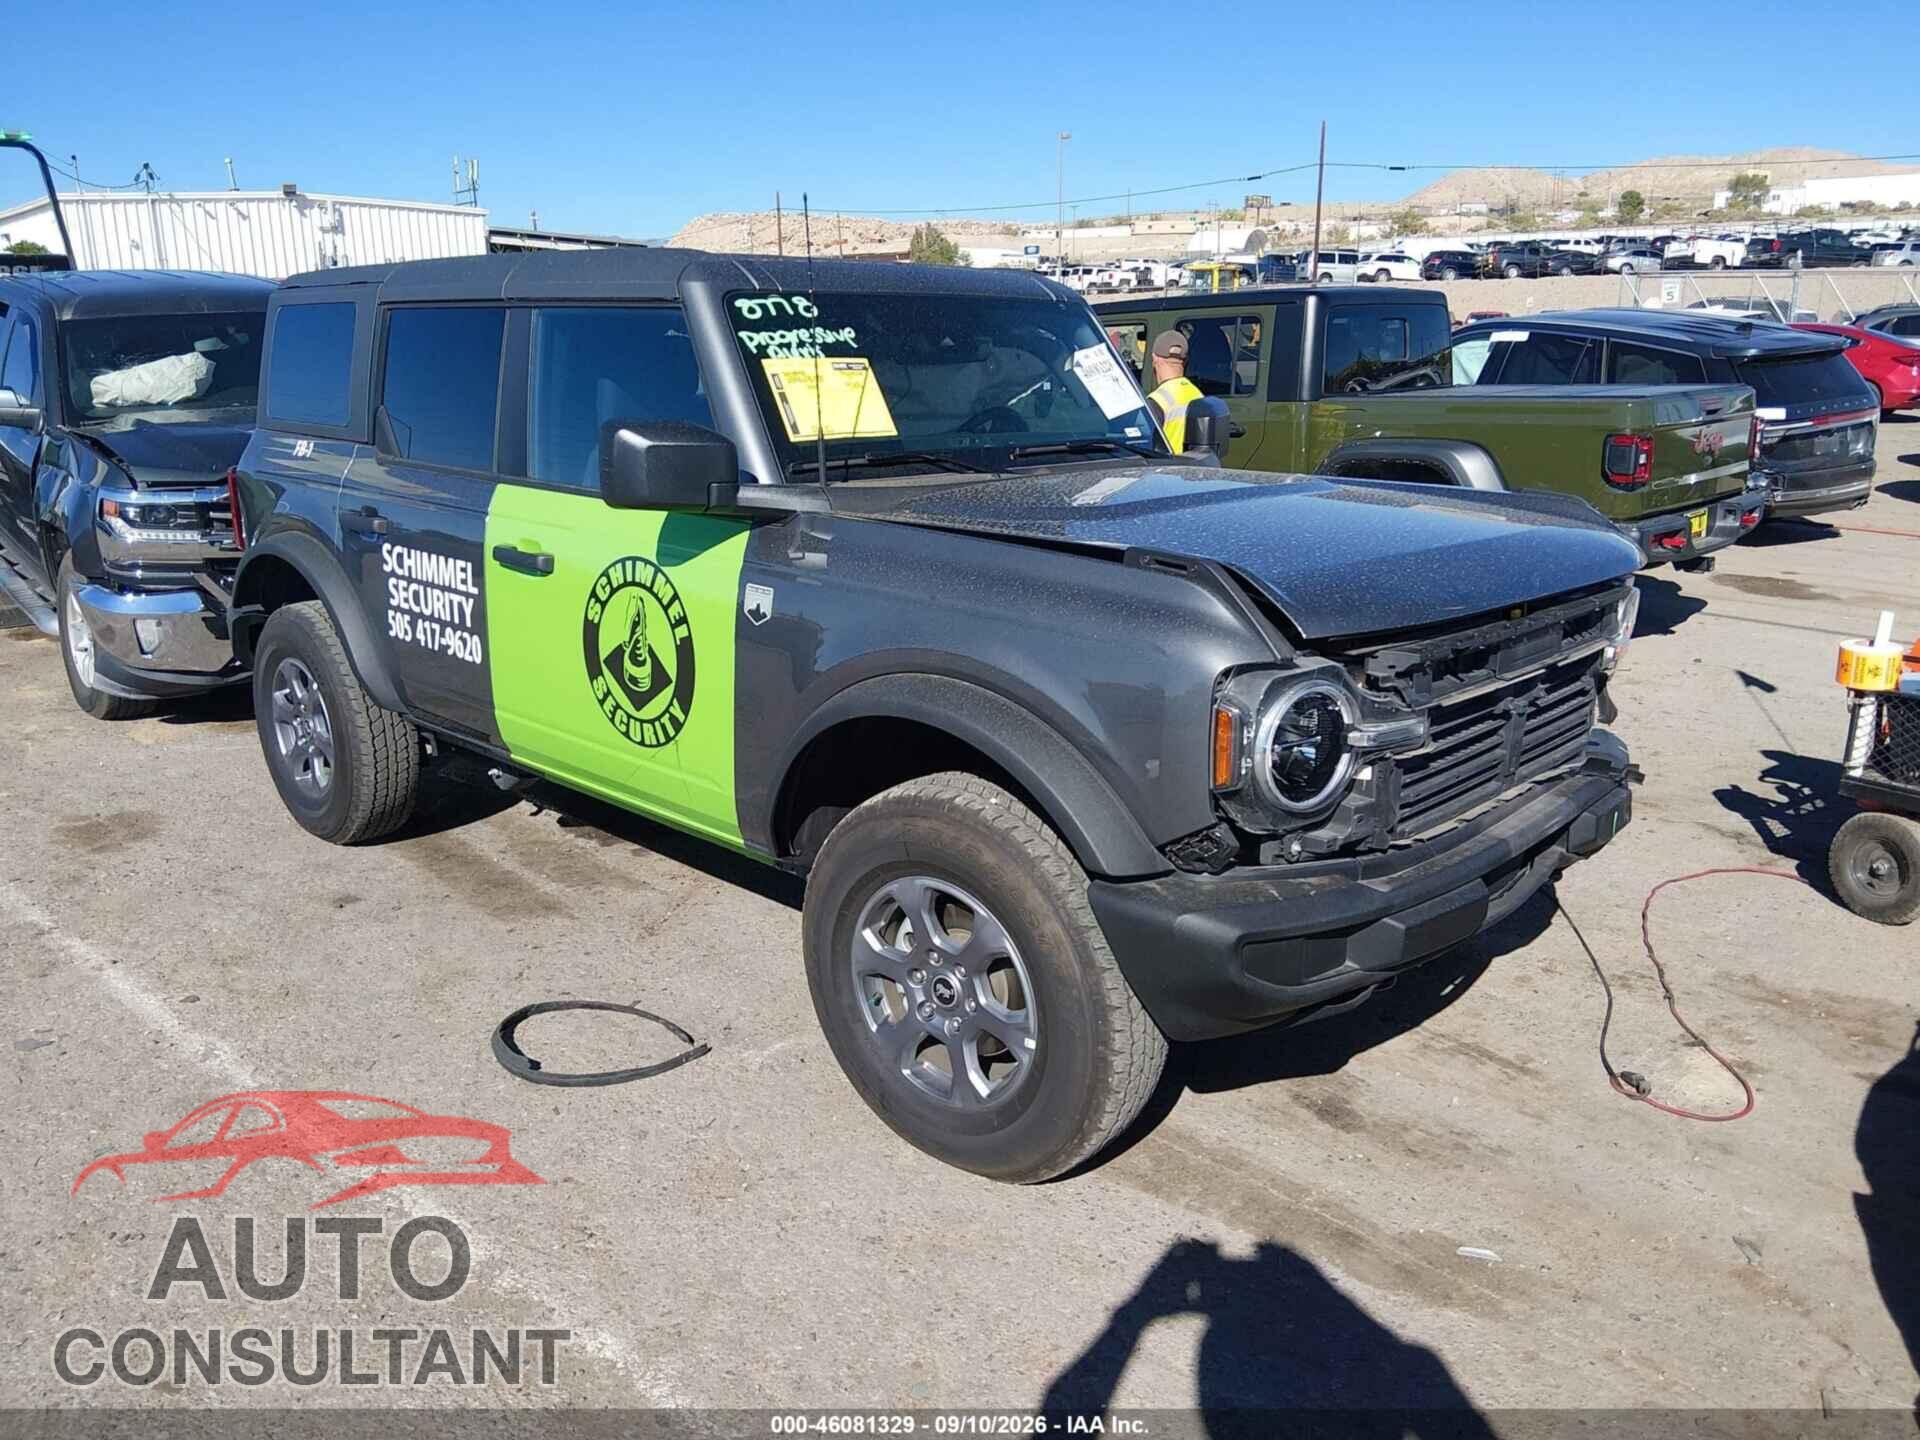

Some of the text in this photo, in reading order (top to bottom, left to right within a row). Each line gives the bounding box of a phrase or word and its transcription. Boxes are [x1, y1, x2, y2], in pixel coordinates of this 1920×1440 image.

[1666, 291, 1674, 301] 5
[382, 543, 479, 594] SCHIMMEL
[388, 577, 474, 628] SECURITY
[587, 560, 690, 645] SCHIMMEL
[388, 610, 482, 664] 505 417-9620
[593, 676, 685, 746] SECURITY
